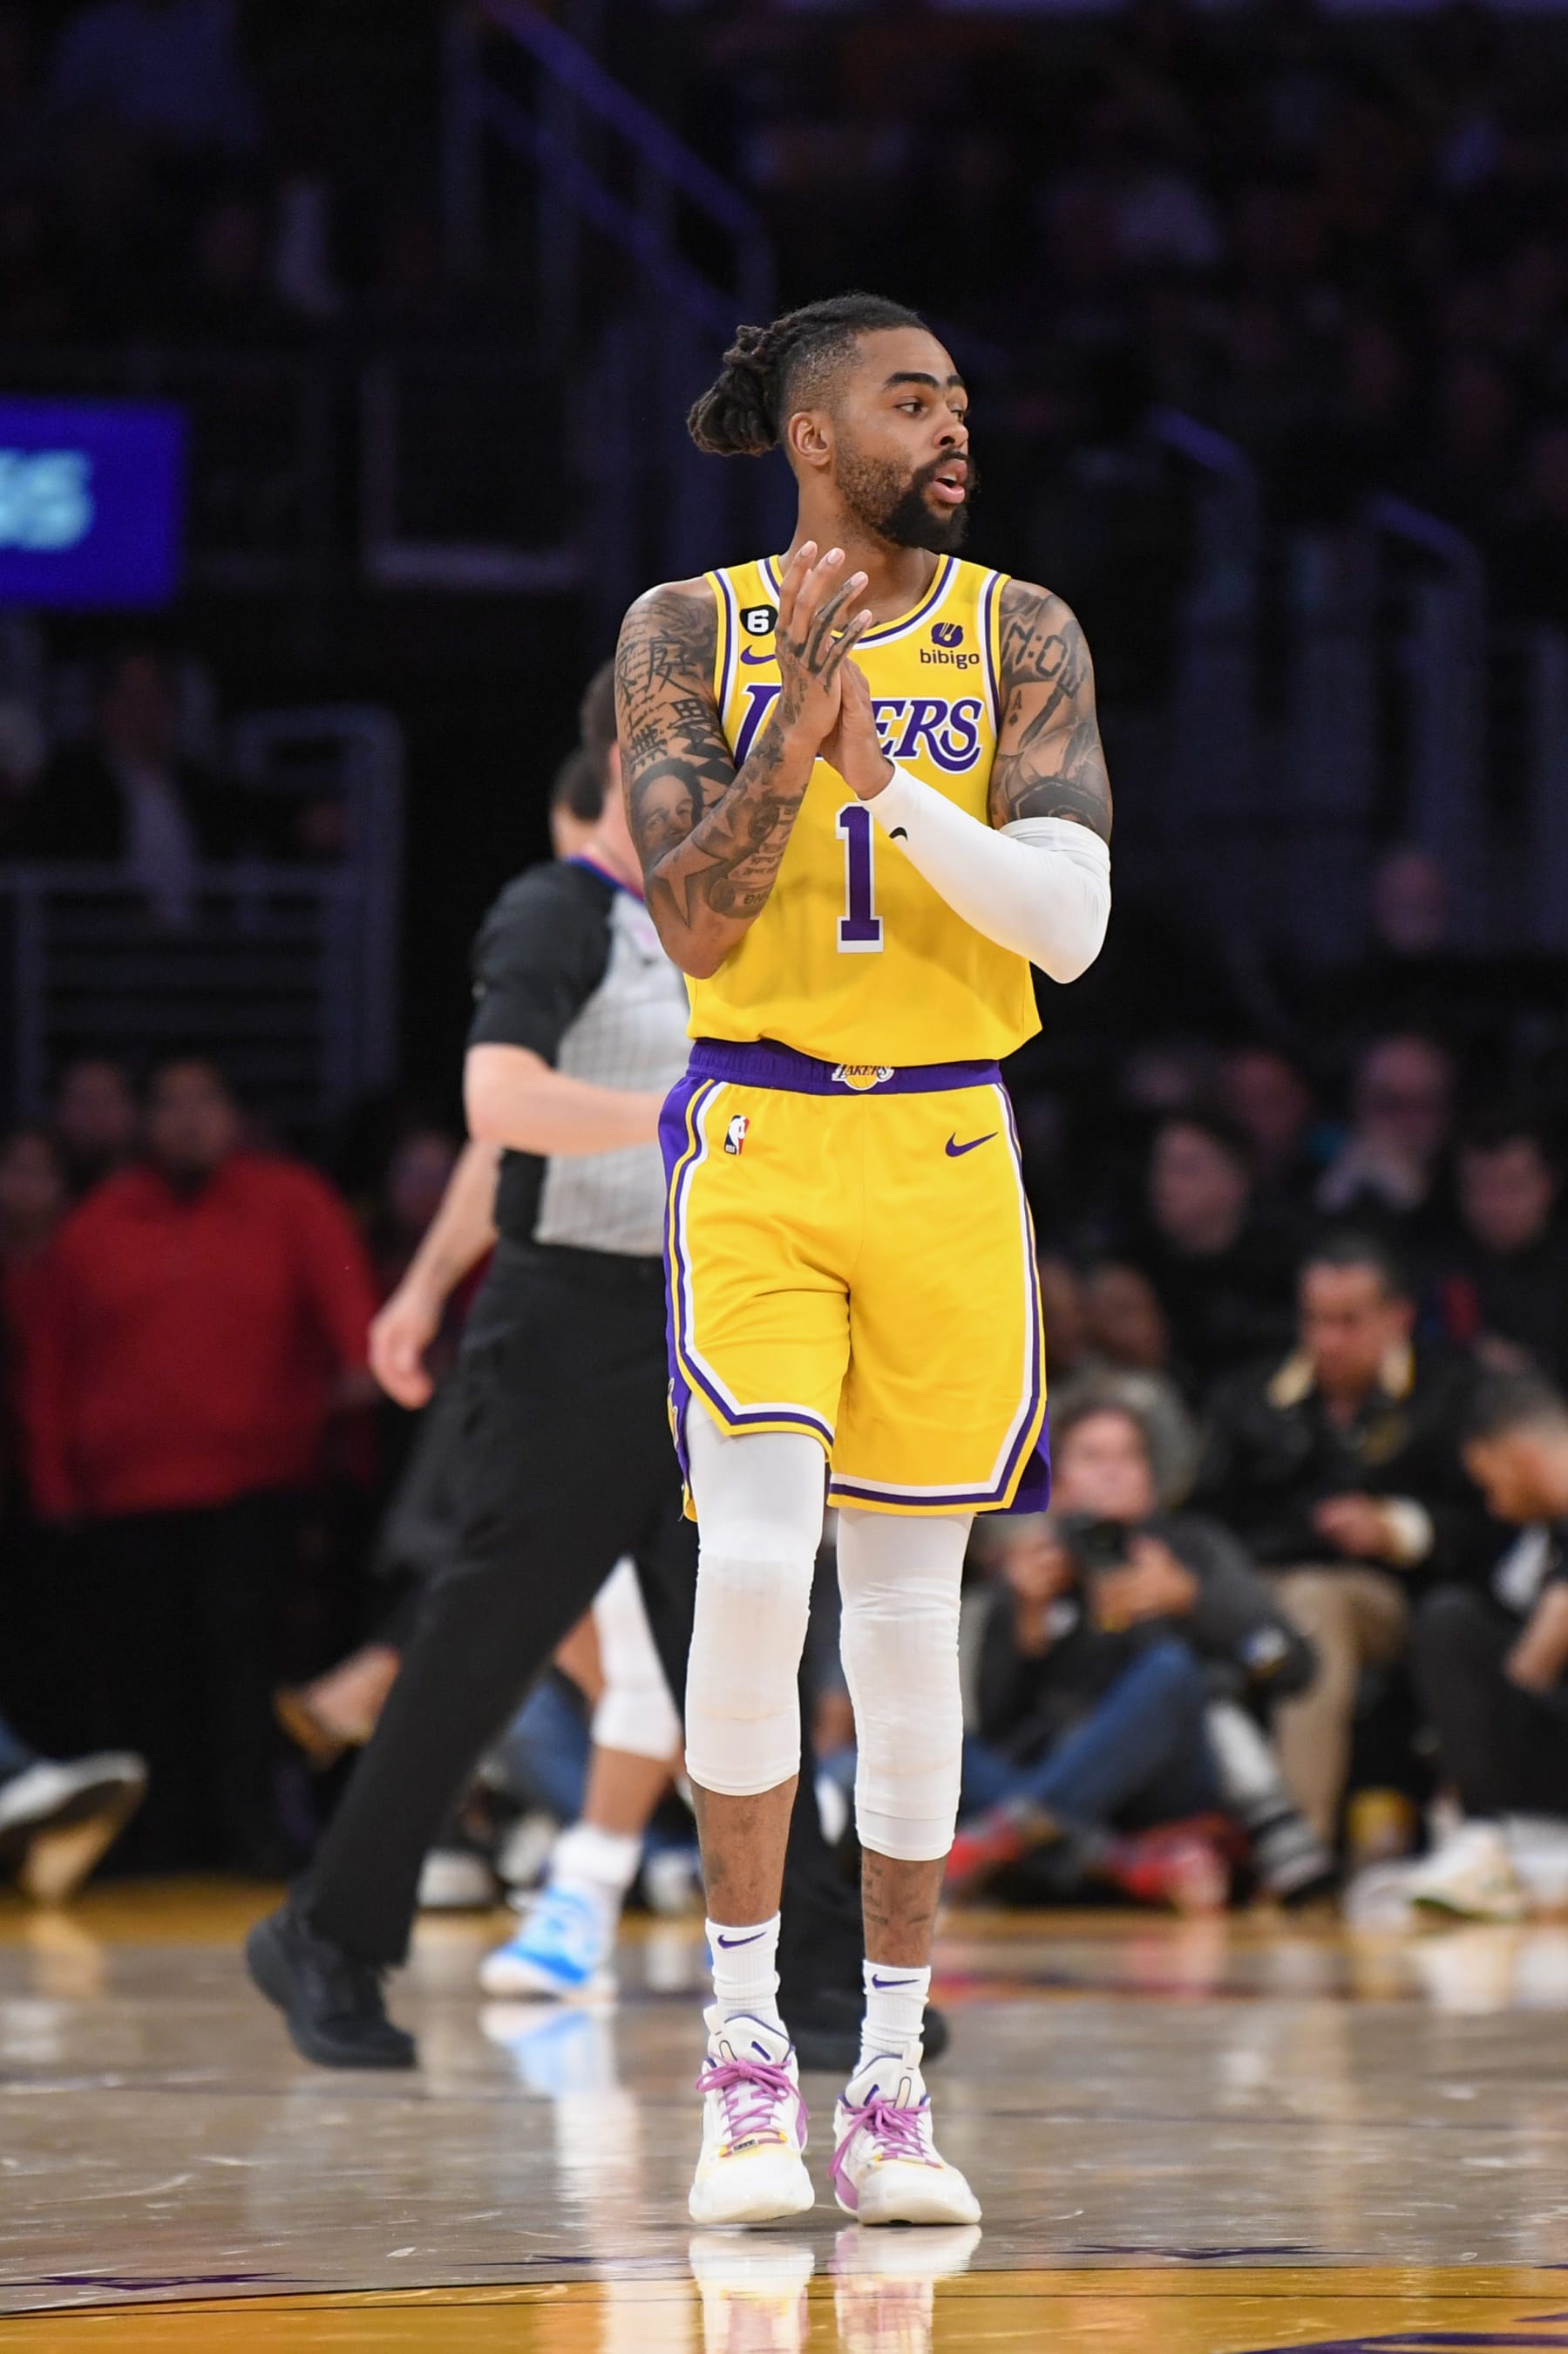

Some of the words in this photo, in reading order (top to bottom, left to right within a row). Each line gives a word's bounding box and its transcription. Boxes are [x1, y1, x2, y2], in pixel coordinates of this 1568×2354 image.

[747, 609, 770, 634] 6
[920, 648, 981, 670] bibigo
[836, 802, 884, 952] 1
[832, 1063, 894, 1082] LAKERS
